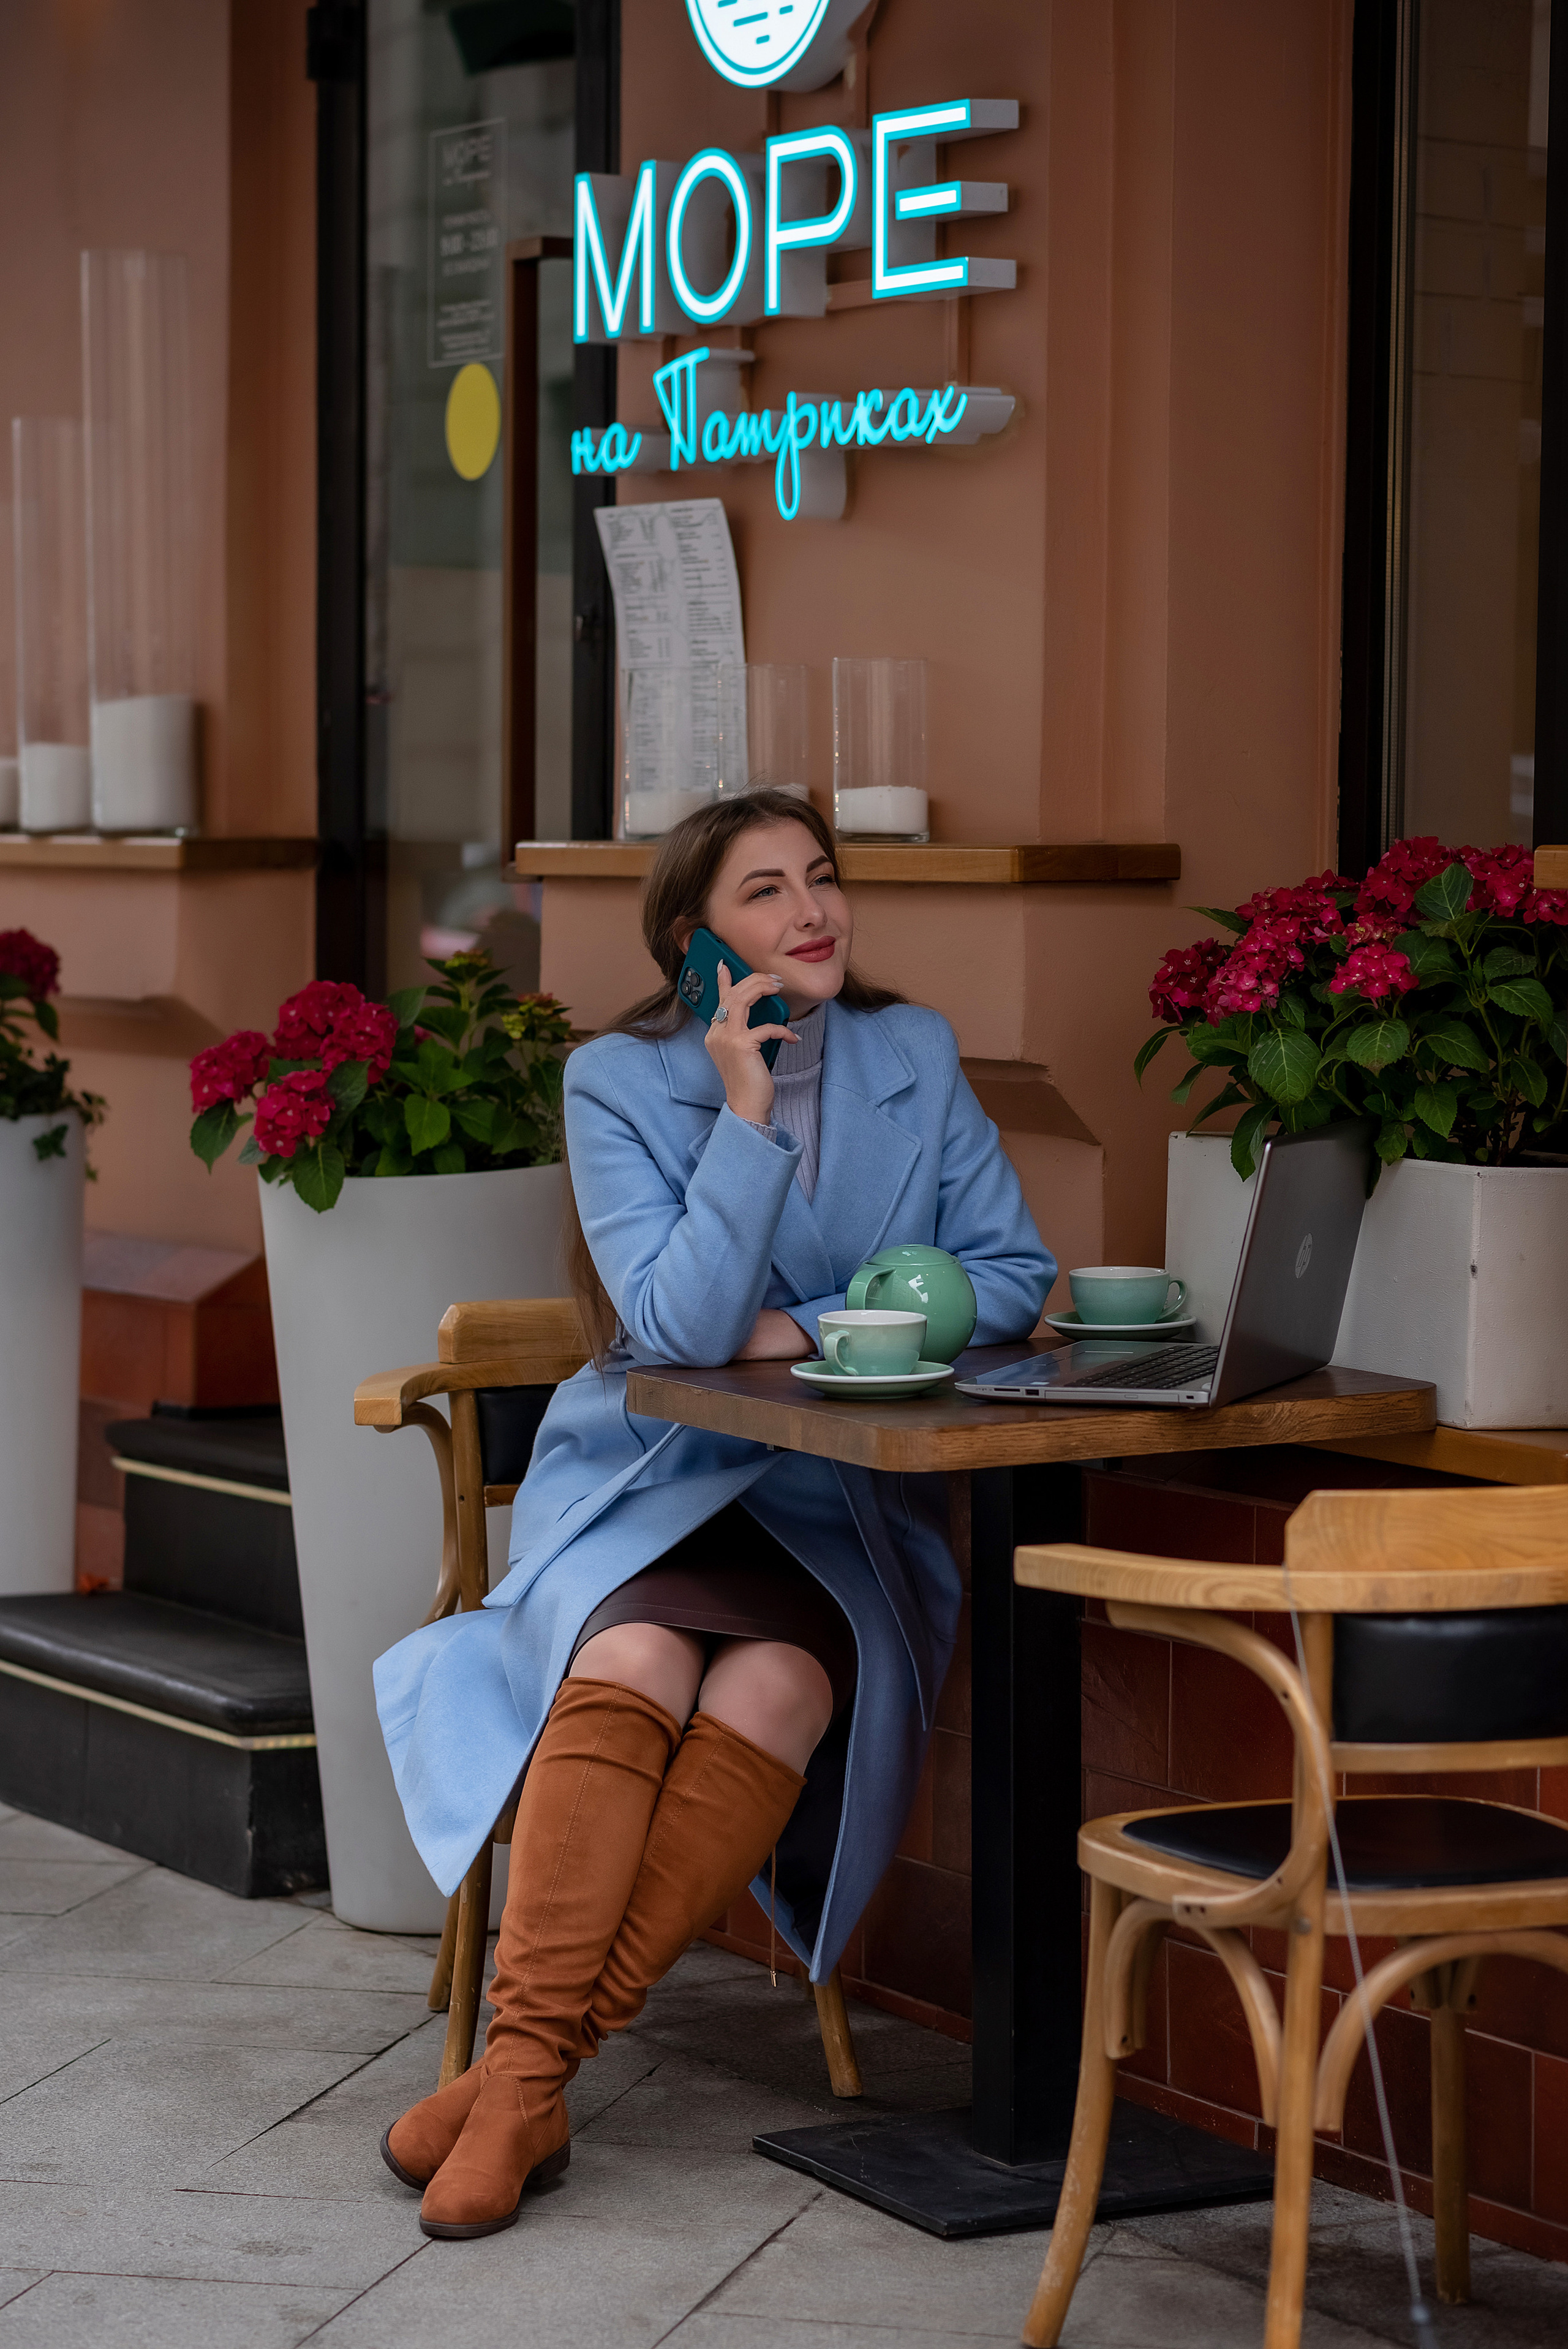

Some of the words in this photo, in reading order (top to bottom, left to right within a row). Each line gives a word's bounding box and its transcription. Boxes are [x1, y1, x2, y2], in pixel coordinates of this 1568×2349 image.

[573, 98, 972, 344] МОРЕ
[571, 422, 642, 475] на
[652, 346, 968, 521] Патриках
[1295, 1233, 1312, 1279] hp
